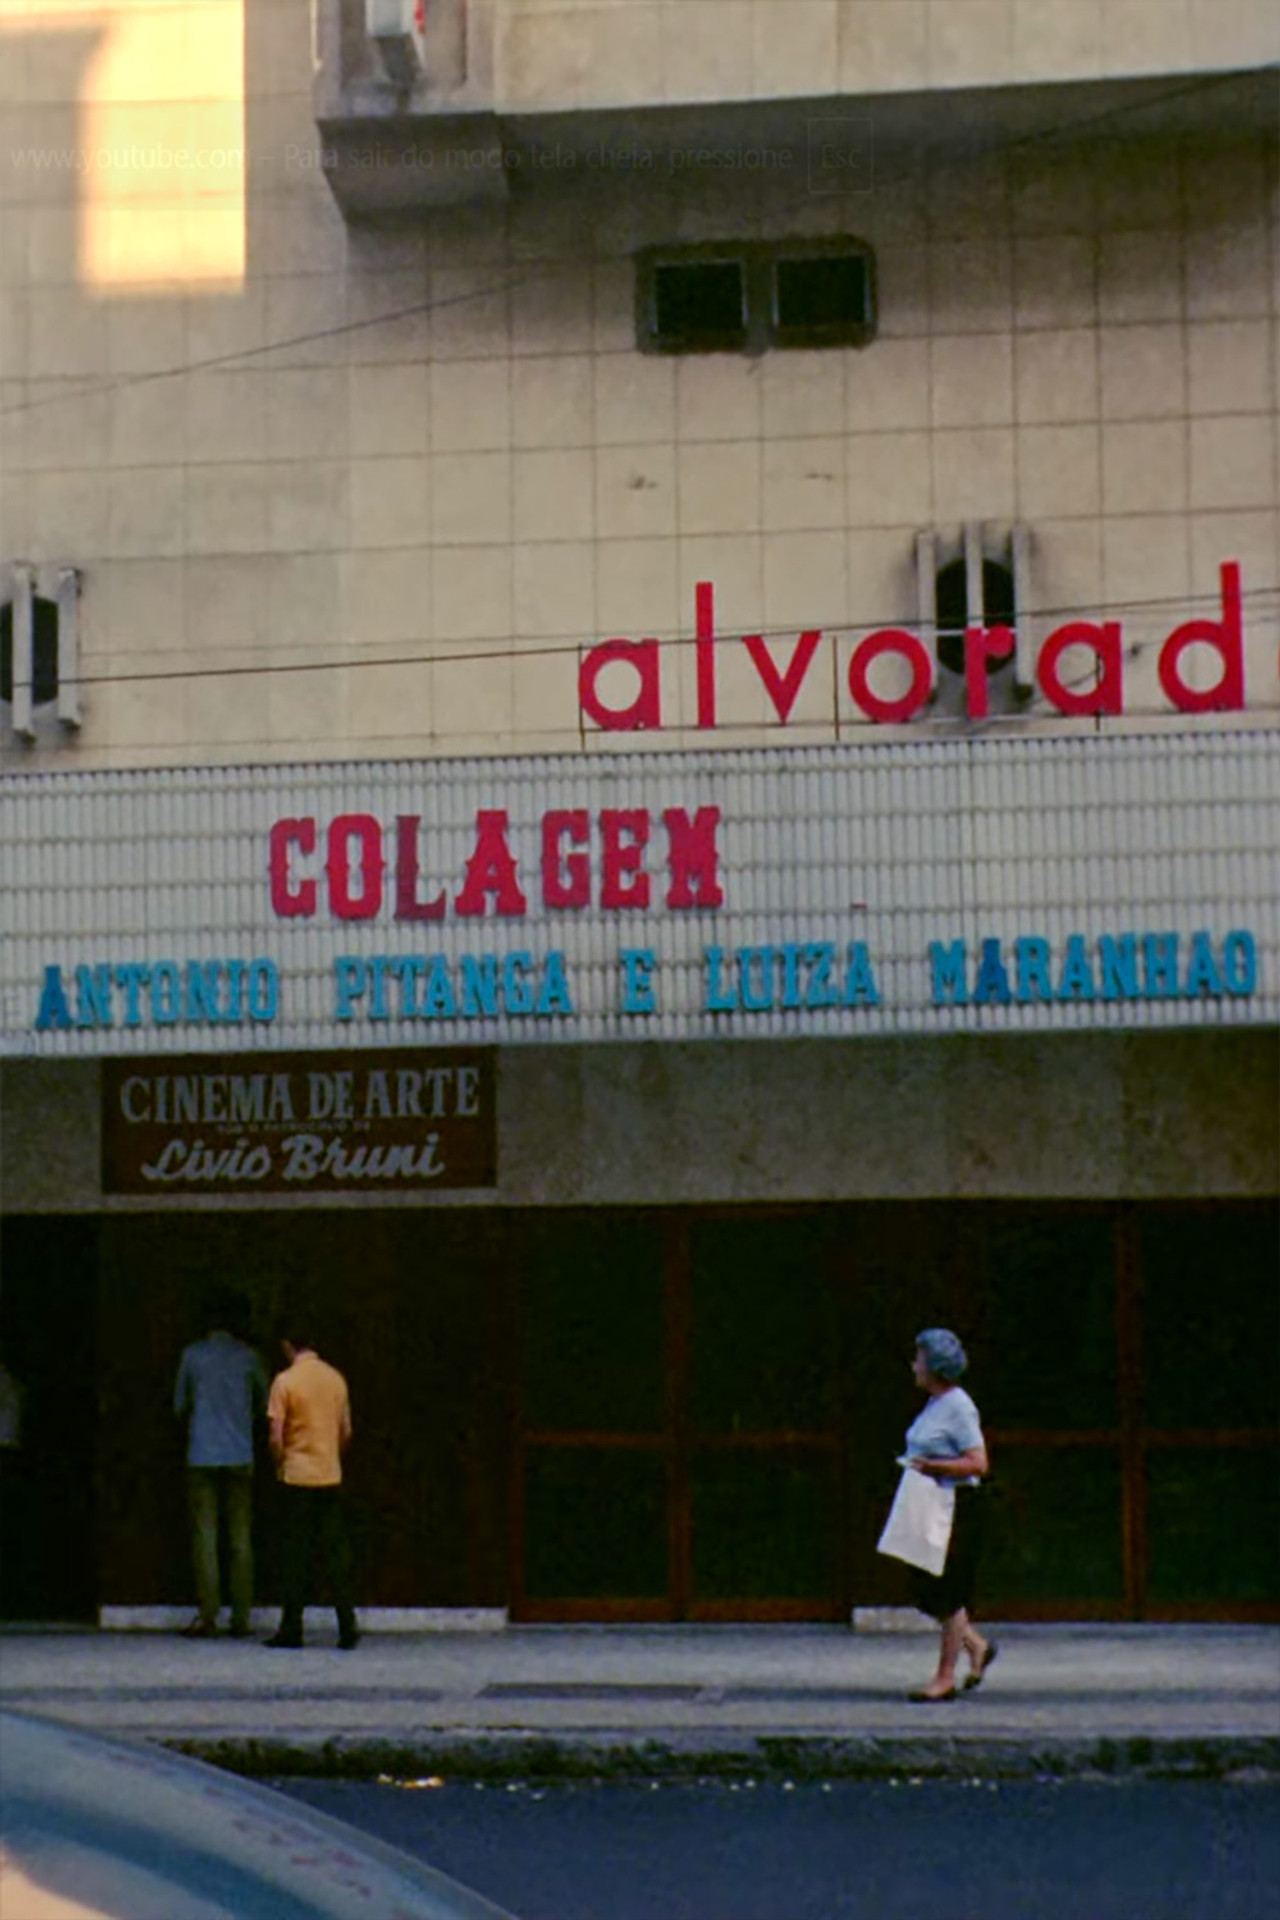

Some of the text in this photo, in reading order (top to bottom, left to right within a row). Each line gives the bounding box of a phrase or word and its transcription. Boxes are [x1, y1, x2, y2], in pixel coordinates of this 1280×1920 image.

[578, 561, 1280, 732] alvorad
[268, 805, 724, 920] COLAGEM
[34, 929, 1256, 1029] ANTONIO PITANGA E LUIZA MARANHAO
[119, 1067, 480, 1124] CINEMA DE ARTE
[281, 1133, 446, 1180] Bruni
